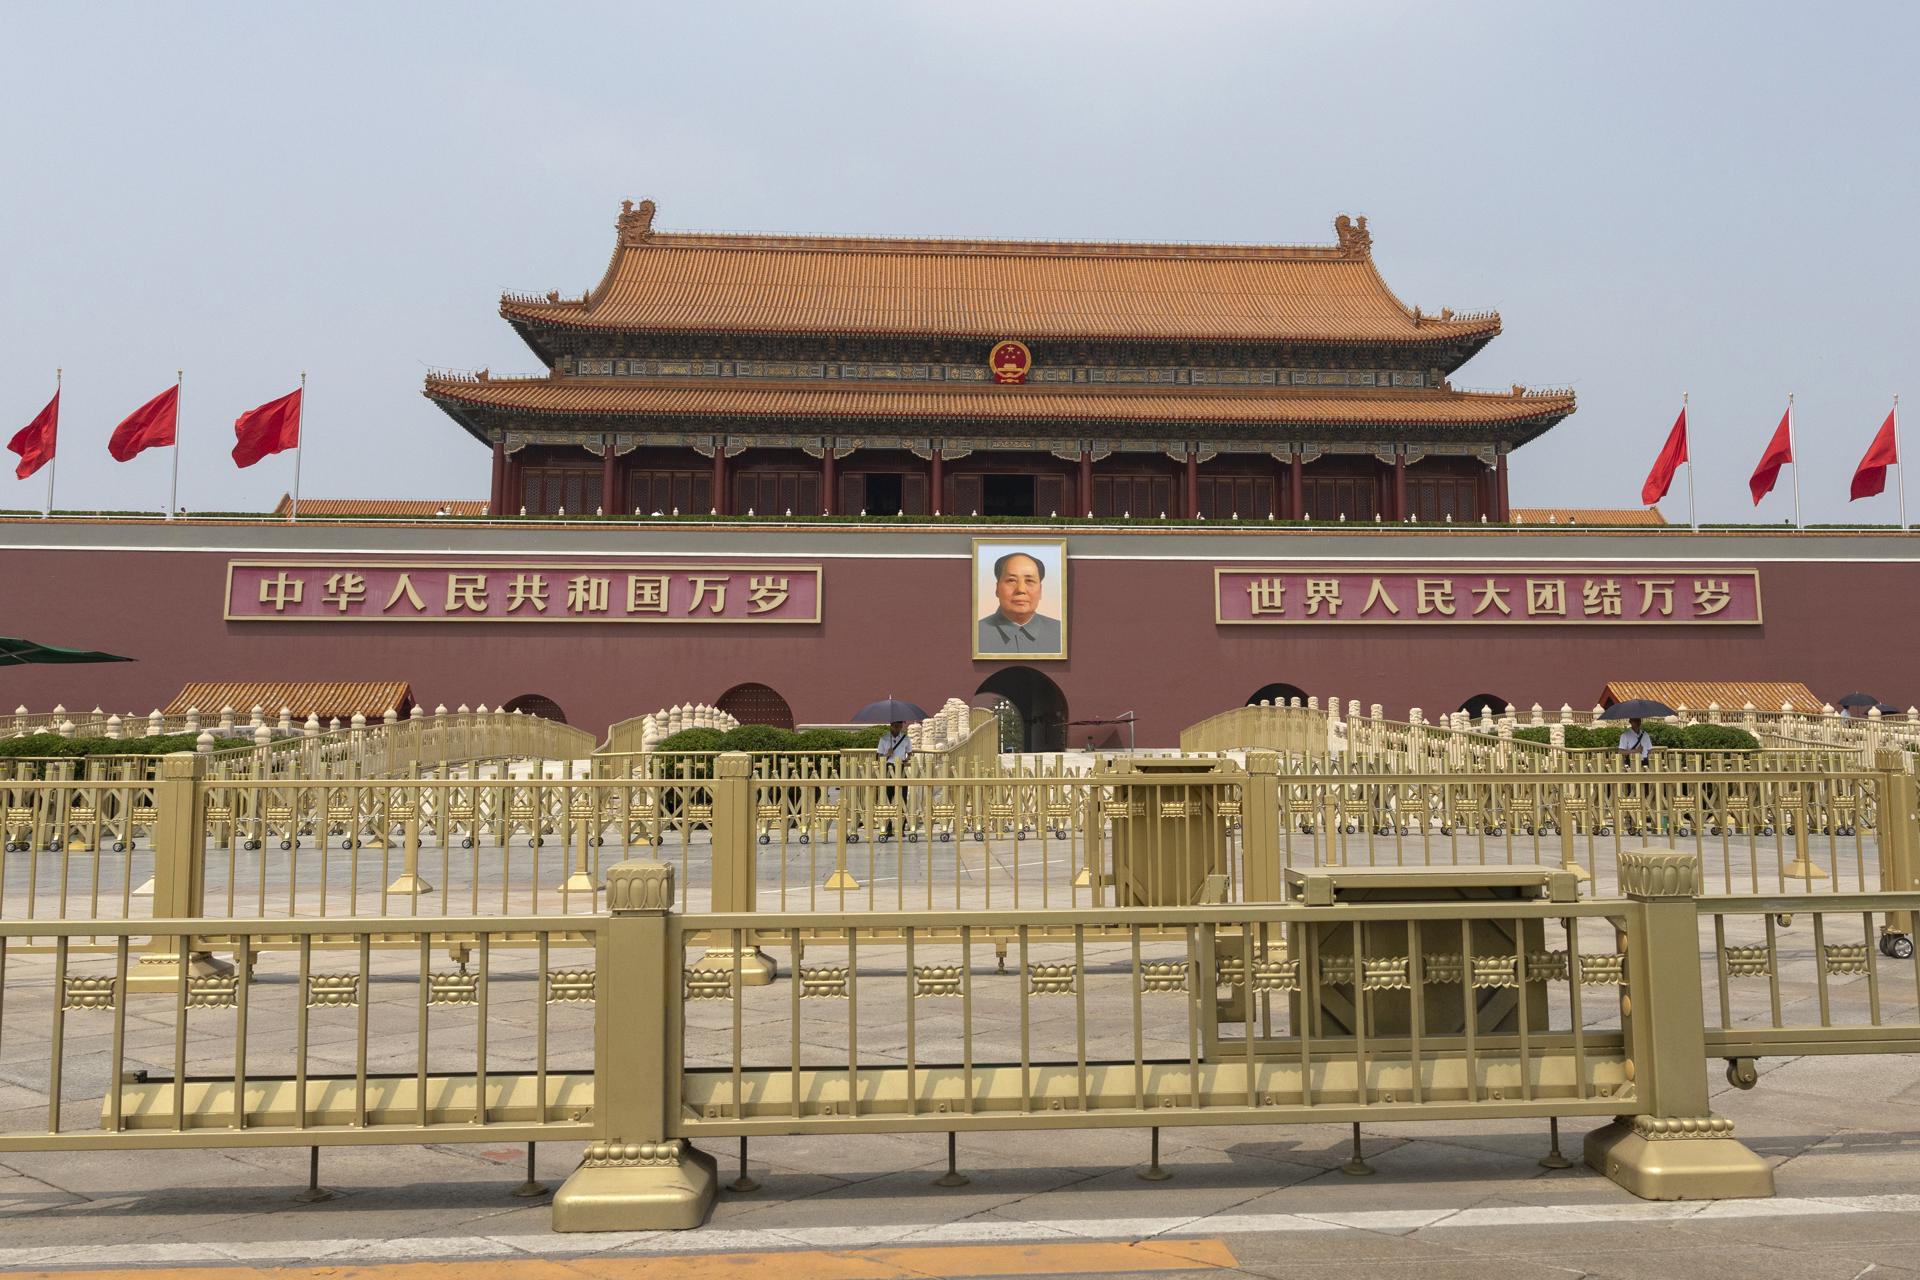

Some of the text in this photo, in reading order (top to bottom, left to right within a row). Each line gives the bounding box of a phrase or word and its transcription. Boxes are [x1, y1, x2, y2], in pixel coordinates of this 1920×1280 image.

[258, 572, 790, 614] 中华人民共和国万岁
[1246, 577, 1732, 616] 世界人民大团结万岁
